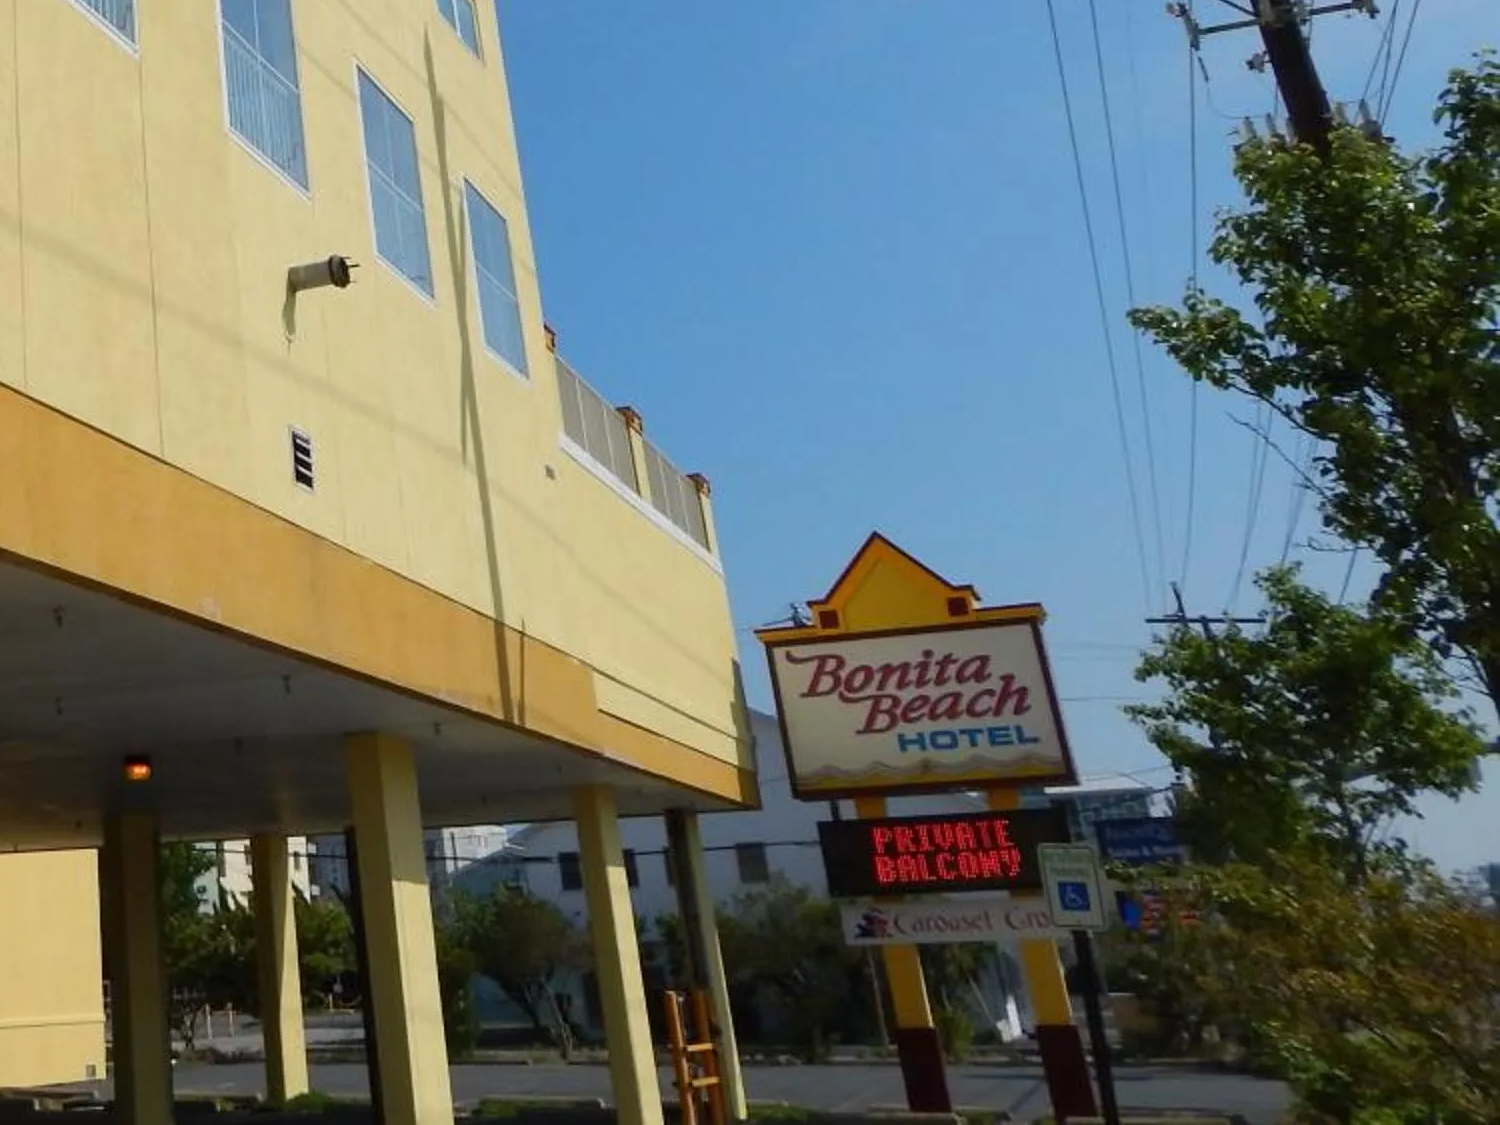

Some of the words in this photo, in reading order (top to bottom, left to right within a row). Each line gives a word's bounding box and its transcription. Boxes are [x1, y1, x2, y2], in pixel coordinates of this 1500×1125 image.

[785, 649, 992, 698] Bonita
[838, 672, 1032, 735] Beach
[896, 725, 1040, 753] HOTEL
[872, 820, 1016, 853] PRIVATE
[874, 848, 1020, 884] BALCONY
[894, 910, 994, 936] Carousel
